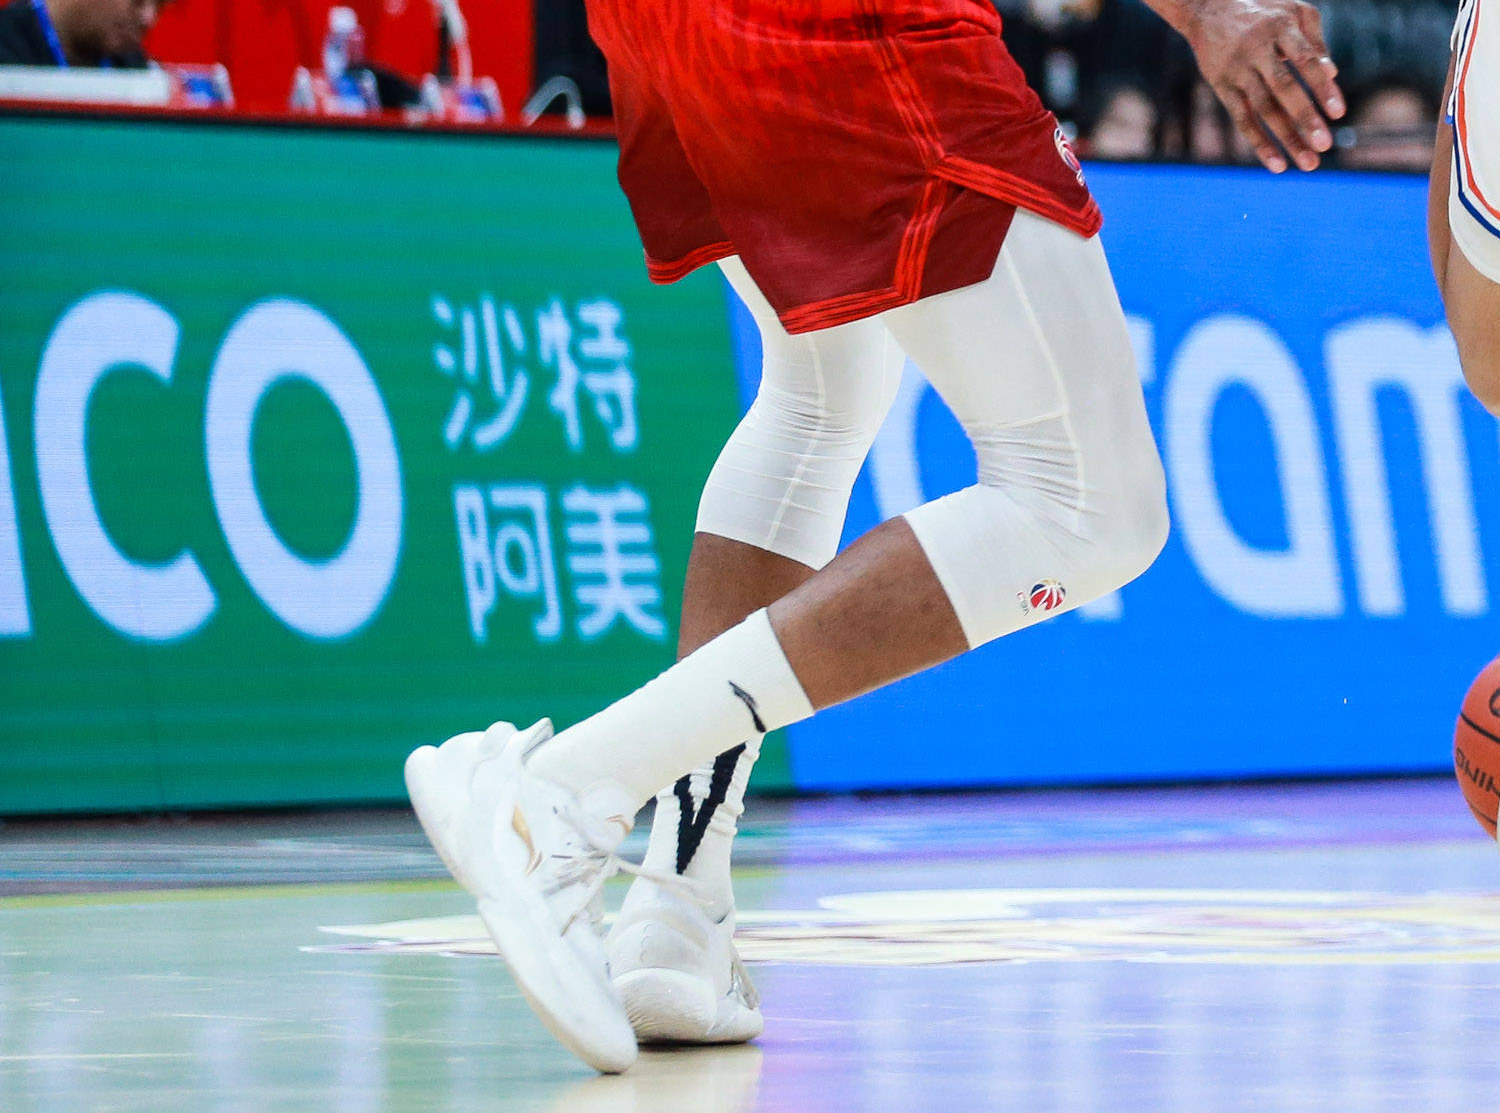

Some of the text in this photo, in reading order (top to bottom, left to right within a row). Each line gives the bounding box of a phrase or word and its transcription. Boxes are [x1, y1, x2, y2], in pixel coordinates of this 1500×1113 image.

[430, 290, 641, 455] 沙特
[0, 289, 406, 644] co
[453, 480, 669, 645] 阿美
